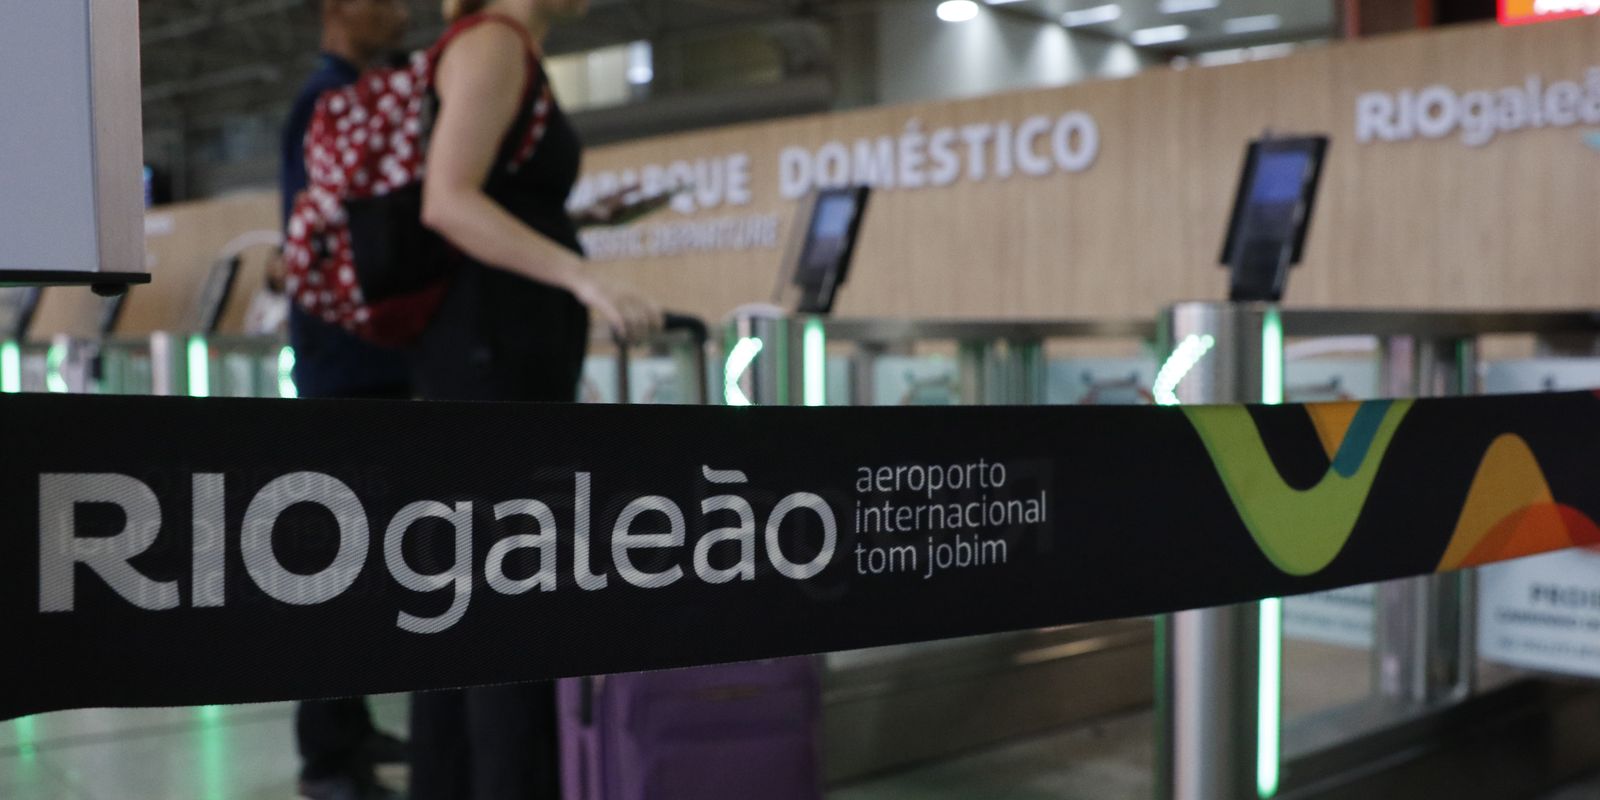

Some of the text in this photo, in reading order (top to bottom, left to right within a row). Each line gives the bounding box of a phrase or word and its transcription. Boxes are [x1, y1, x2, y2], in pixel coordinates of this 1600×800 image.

[778, 110, 1099, 198] DOMÉSTICO
[855, 458, 1006, 498] aeroporto
[854, 490, 1047, 534] internacional
[38, 464, 838, 634] RIOgaleão
[854, 533, 1008, 579] tom jobim
